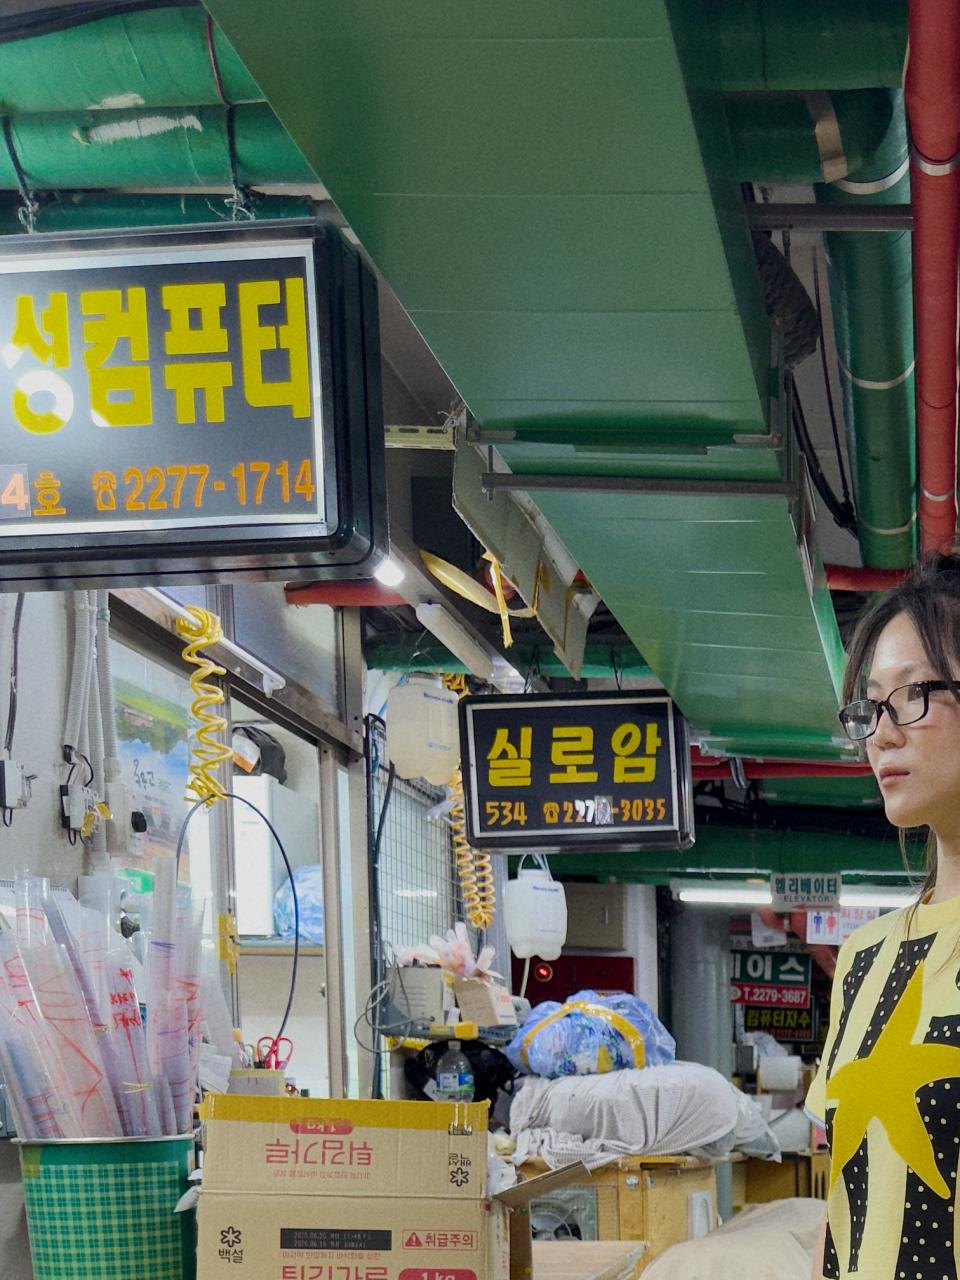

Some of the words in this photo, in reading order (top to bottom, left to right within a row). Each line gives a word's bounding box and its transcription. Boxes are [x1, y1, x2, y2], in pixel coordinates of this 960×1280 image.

[4, 277, 311, 434] 성컴퓨터
[124, 460, 315, 511] 2277-1714
[486, 722, 662, 787] 실로암
[485, 800, 528, 826] 534
[265, 1137, 374, 1166] 튀김가루
[425, 1232, 473, 1249] 취급주의
[218, 1248, 243, 1264] 백설
